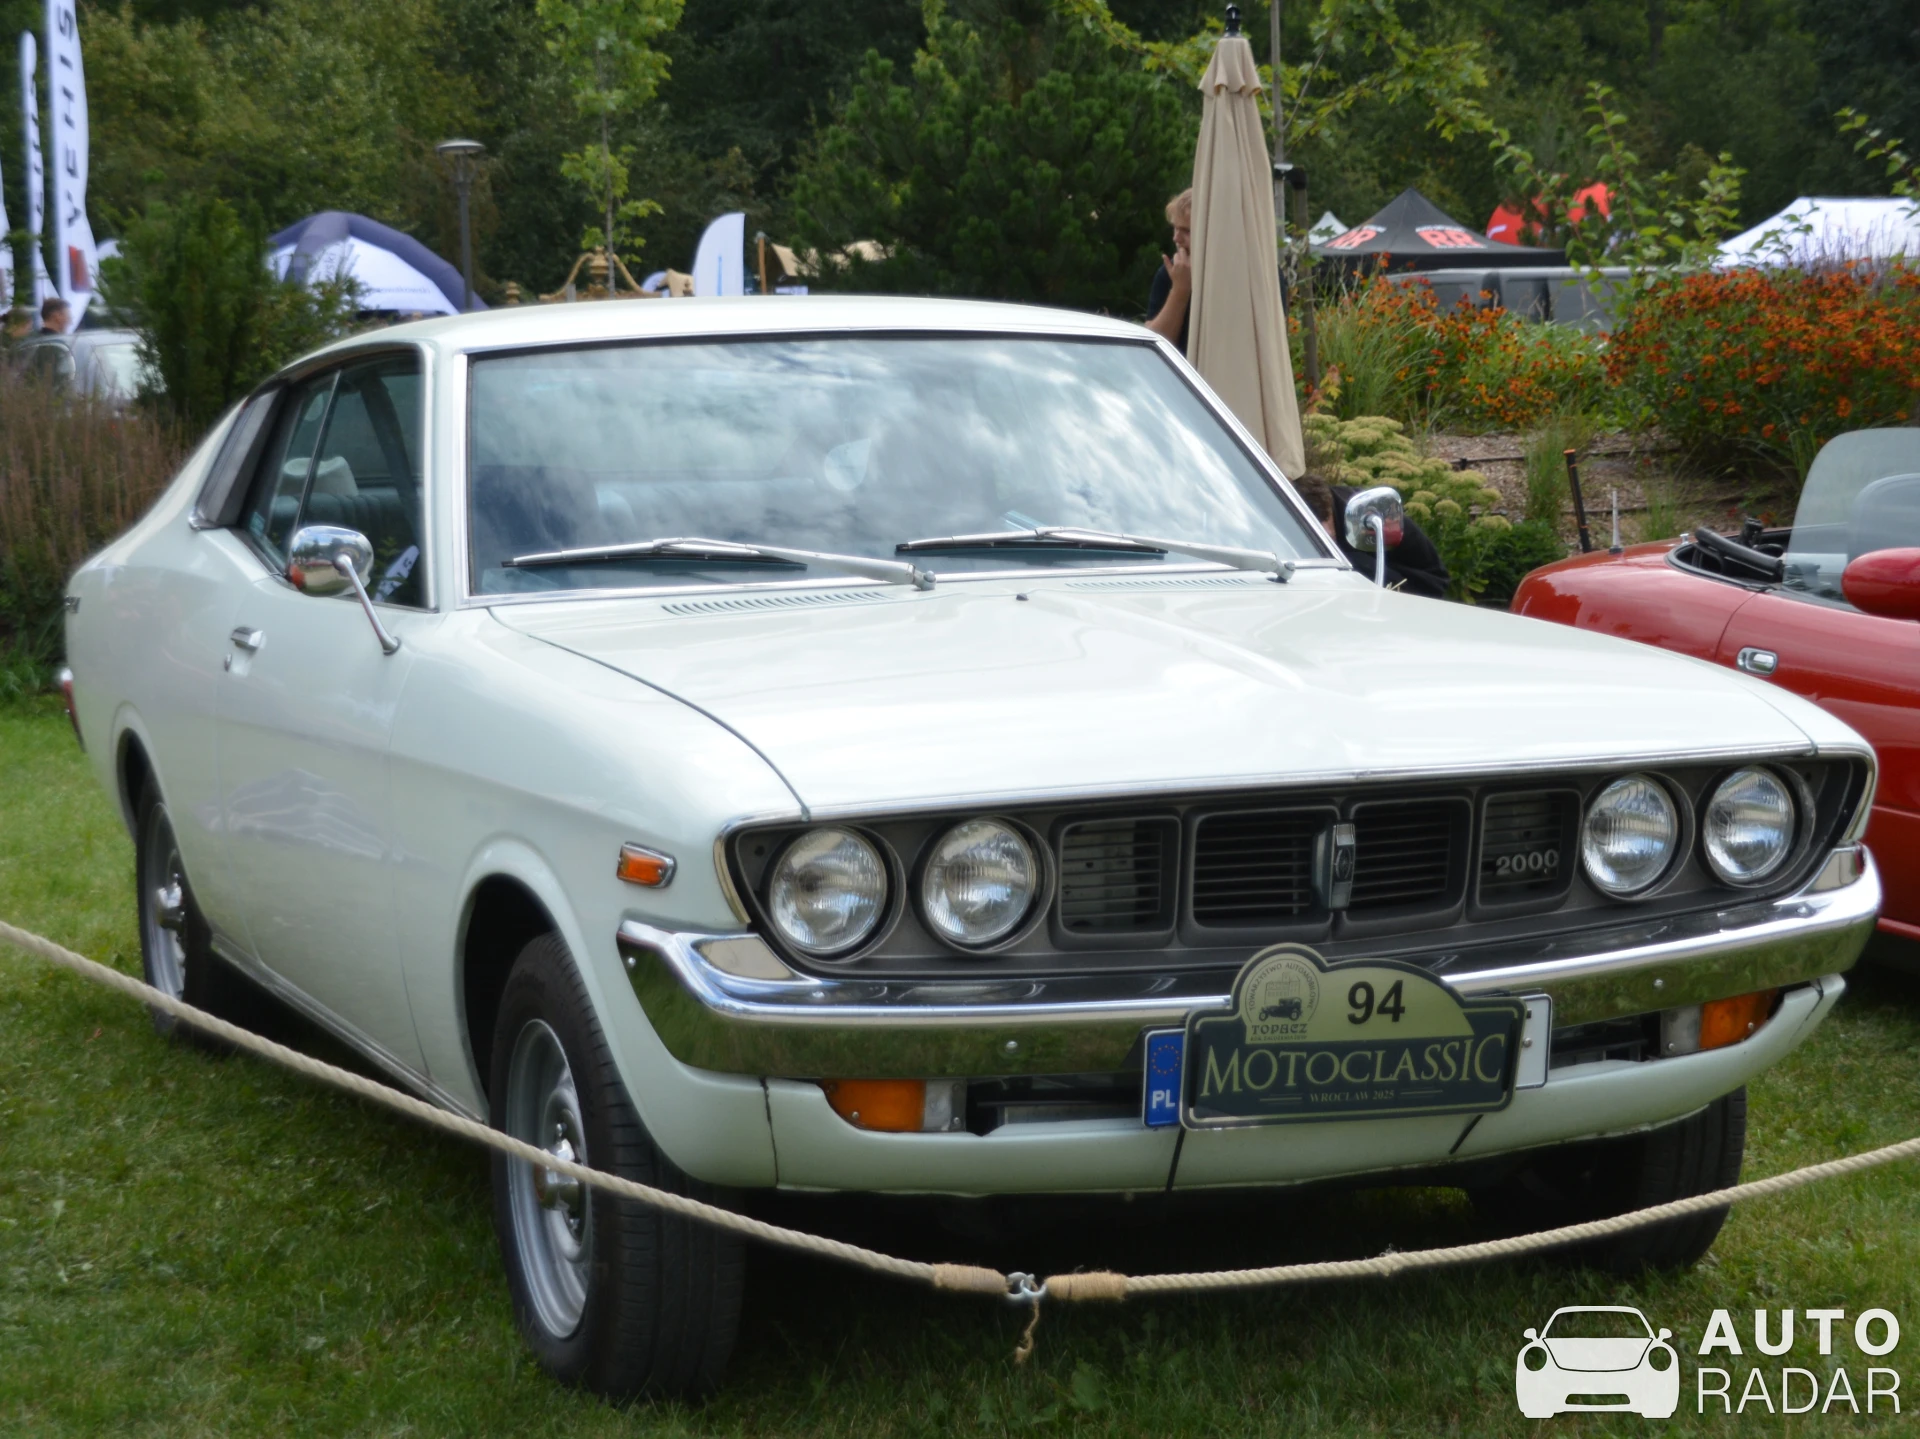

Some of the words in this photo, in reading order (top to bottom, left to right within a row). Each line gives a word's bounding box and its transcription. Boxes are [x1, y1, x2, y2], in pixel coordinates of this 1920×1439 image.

[1496, 849, 1559, 875] 2000
[1249, 963, 1282, 1011] TOWARZYSTWO
[1347, 979, 1406, 1025] 94
[1200, 1033, 1506, 1097] MOTOCLASSIC
[1152, 1089, 1176, 1109] PL
[1373, 1089, 1395, 1100] 2025
